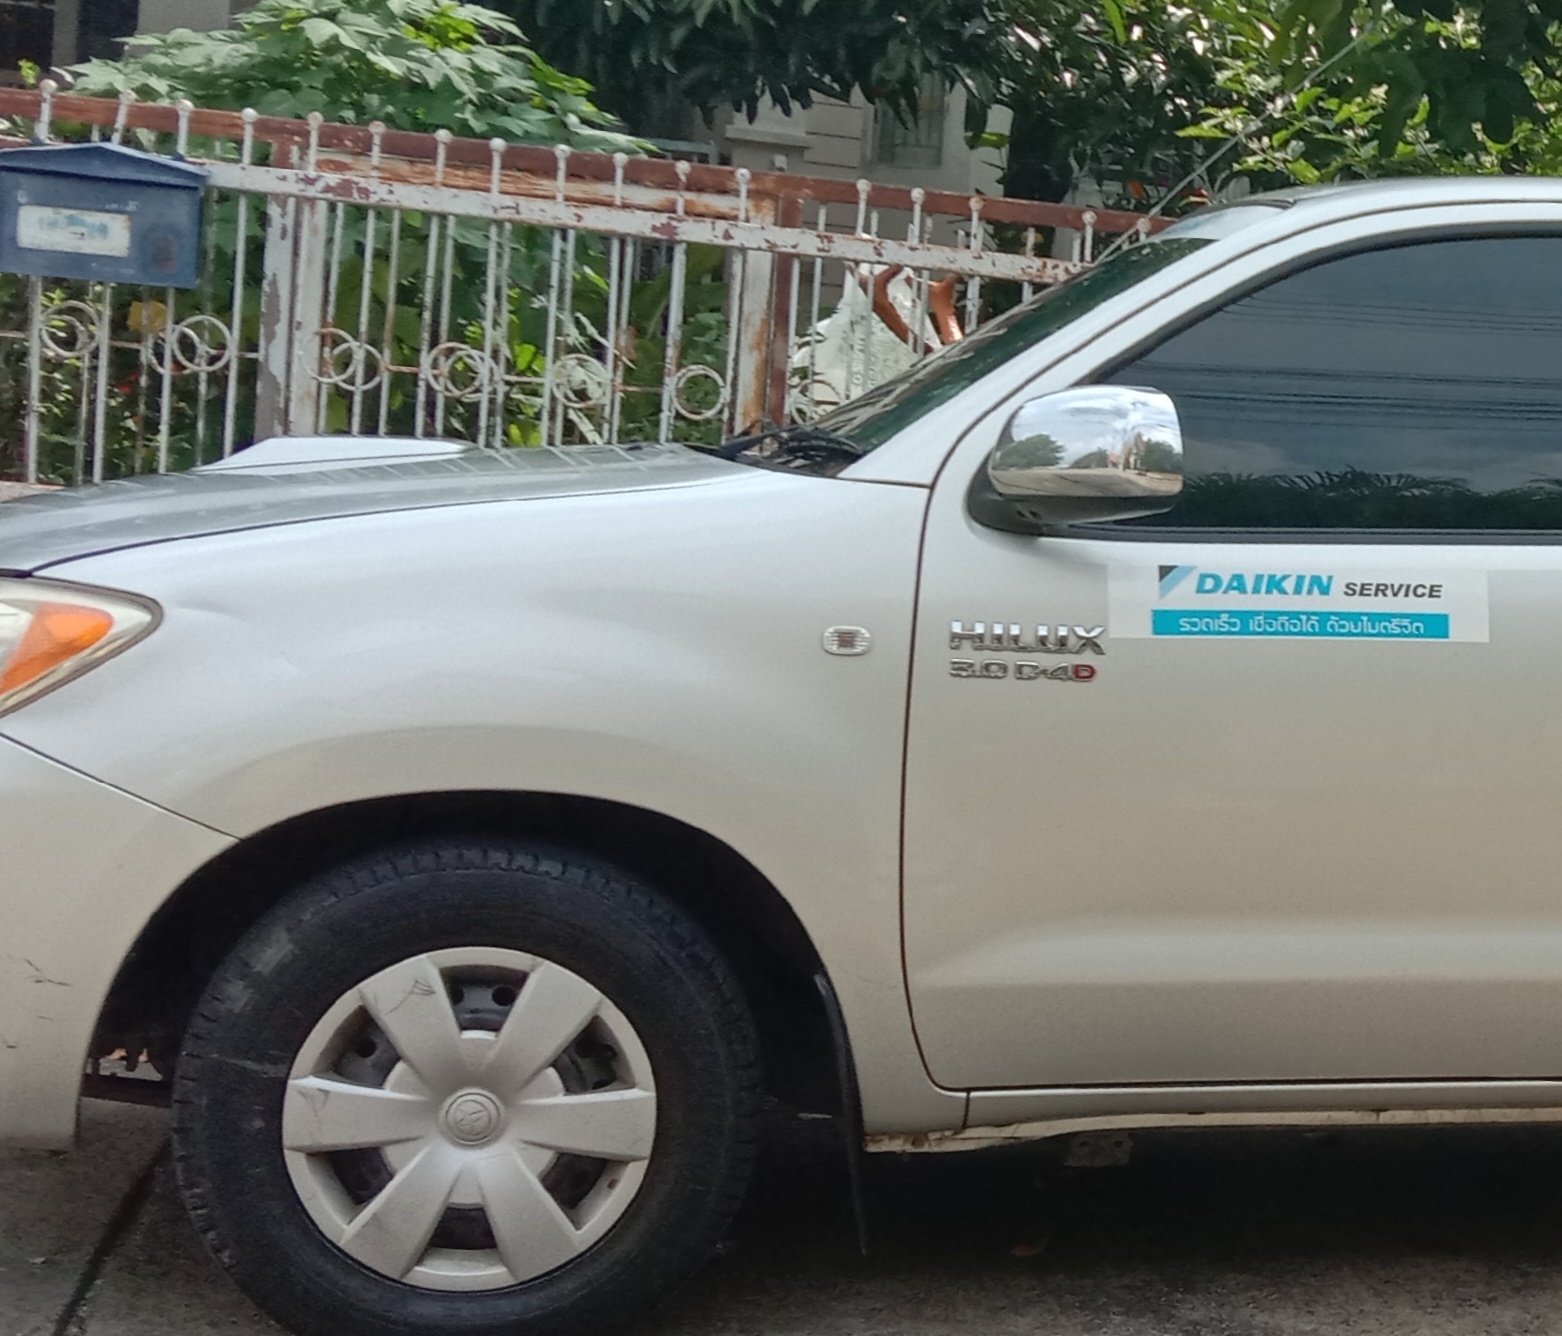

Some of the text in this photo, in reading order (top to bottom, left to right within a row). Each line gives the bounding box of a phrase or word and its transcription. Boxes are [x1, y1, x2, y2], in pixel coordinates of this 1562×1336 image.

[1195, 571, 1443, 598] DAIKIN SERVICE
[1178, 611, 1425, 634] รวดเร็ว เชื่อถือได้ ด้วยไมตรีจิต
[950, 620, 1106, 655] HILUX
[1014, 660, 1097, 682] D-4D
